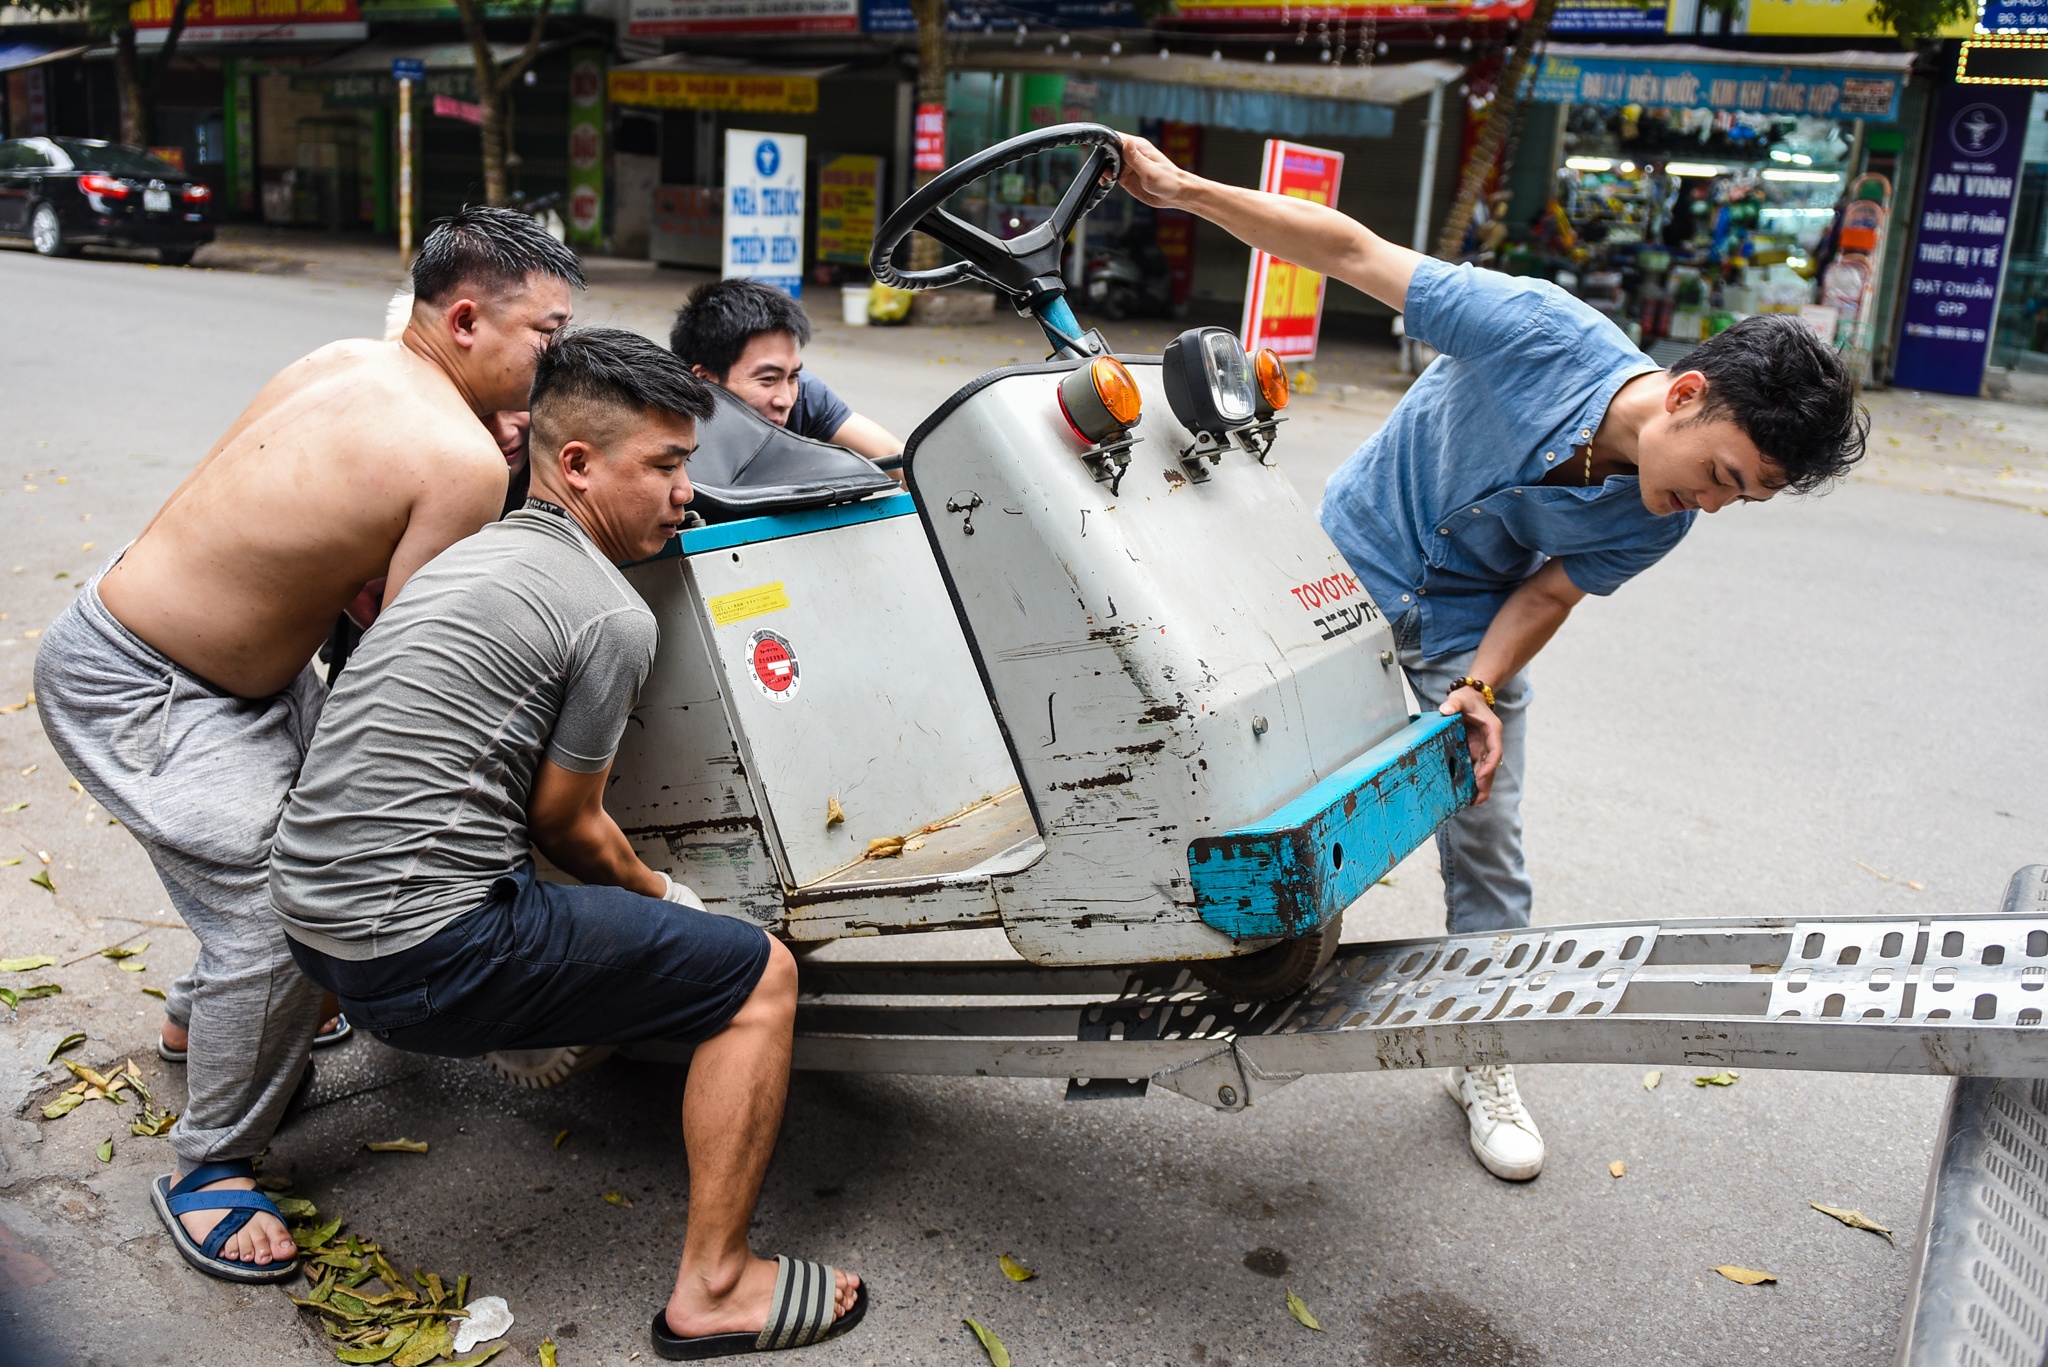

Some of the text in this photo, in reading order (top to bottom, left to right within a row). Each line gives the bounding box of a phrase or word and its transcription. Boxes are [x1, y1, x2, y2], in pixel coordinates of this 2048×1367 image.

[731, 177, 757, 216] NHÀ
[761, 174, 800, 216] THUỐC
[1930, 173, 2013, 199] AN VINH
[1291, 572, 1360, 611] TOYOTA
[752, 673, 757, 681] 9
